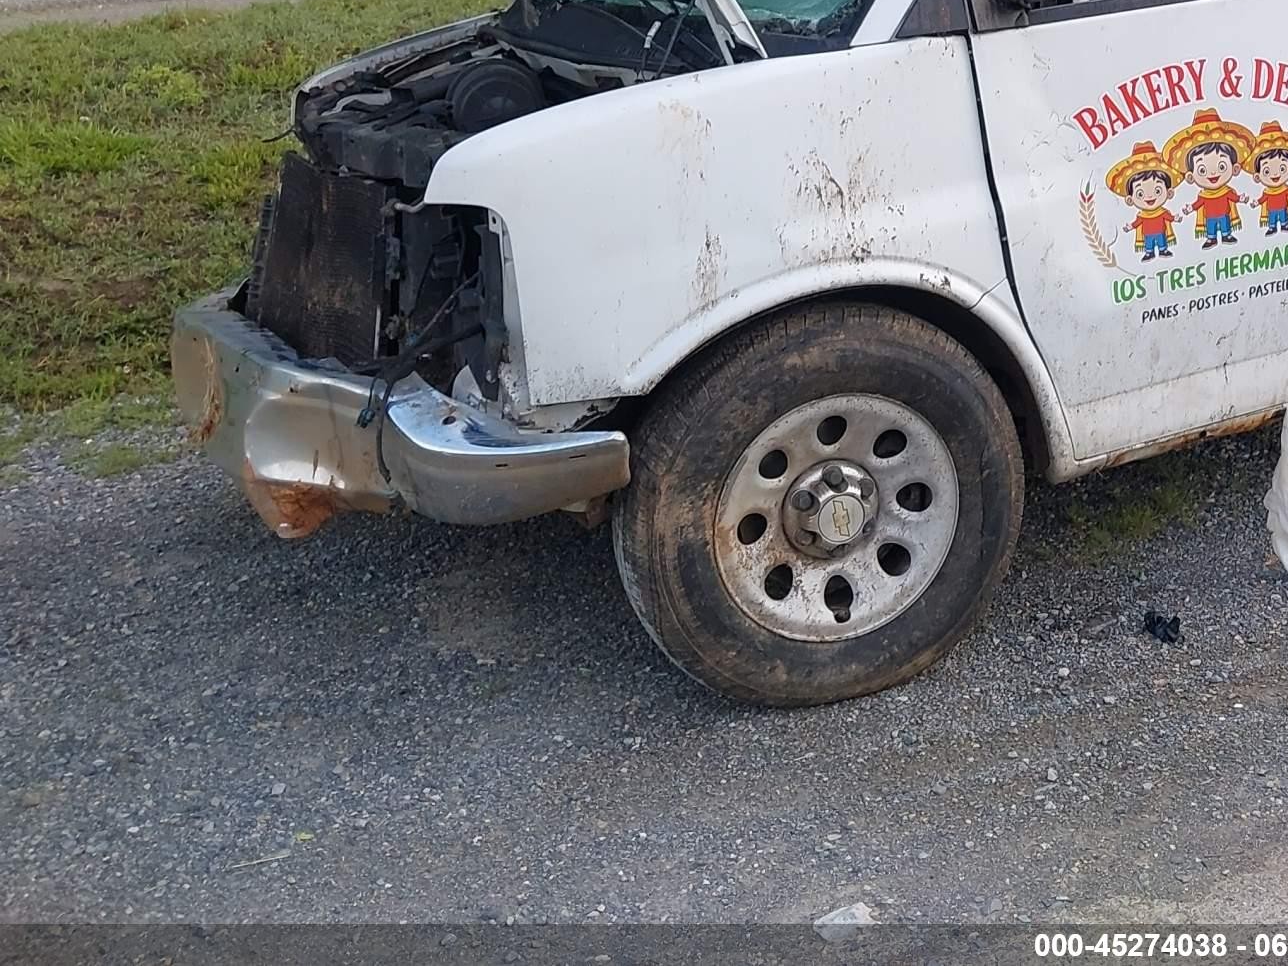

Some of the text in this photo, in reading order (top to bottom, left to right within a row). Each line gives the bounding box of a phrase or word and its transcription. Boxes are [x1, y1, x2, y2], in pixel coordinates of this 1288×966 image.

[1073, 59, 1206, 150] BAKERY
[1219, 58, 1243, 98] &
[1113, 275, 1146, 304] LOS
[1157, 263, 1206, 294] TRES
[1142, 306, 1179, 323] PANES
[1189, 291, 1239, 313] POSTRES
